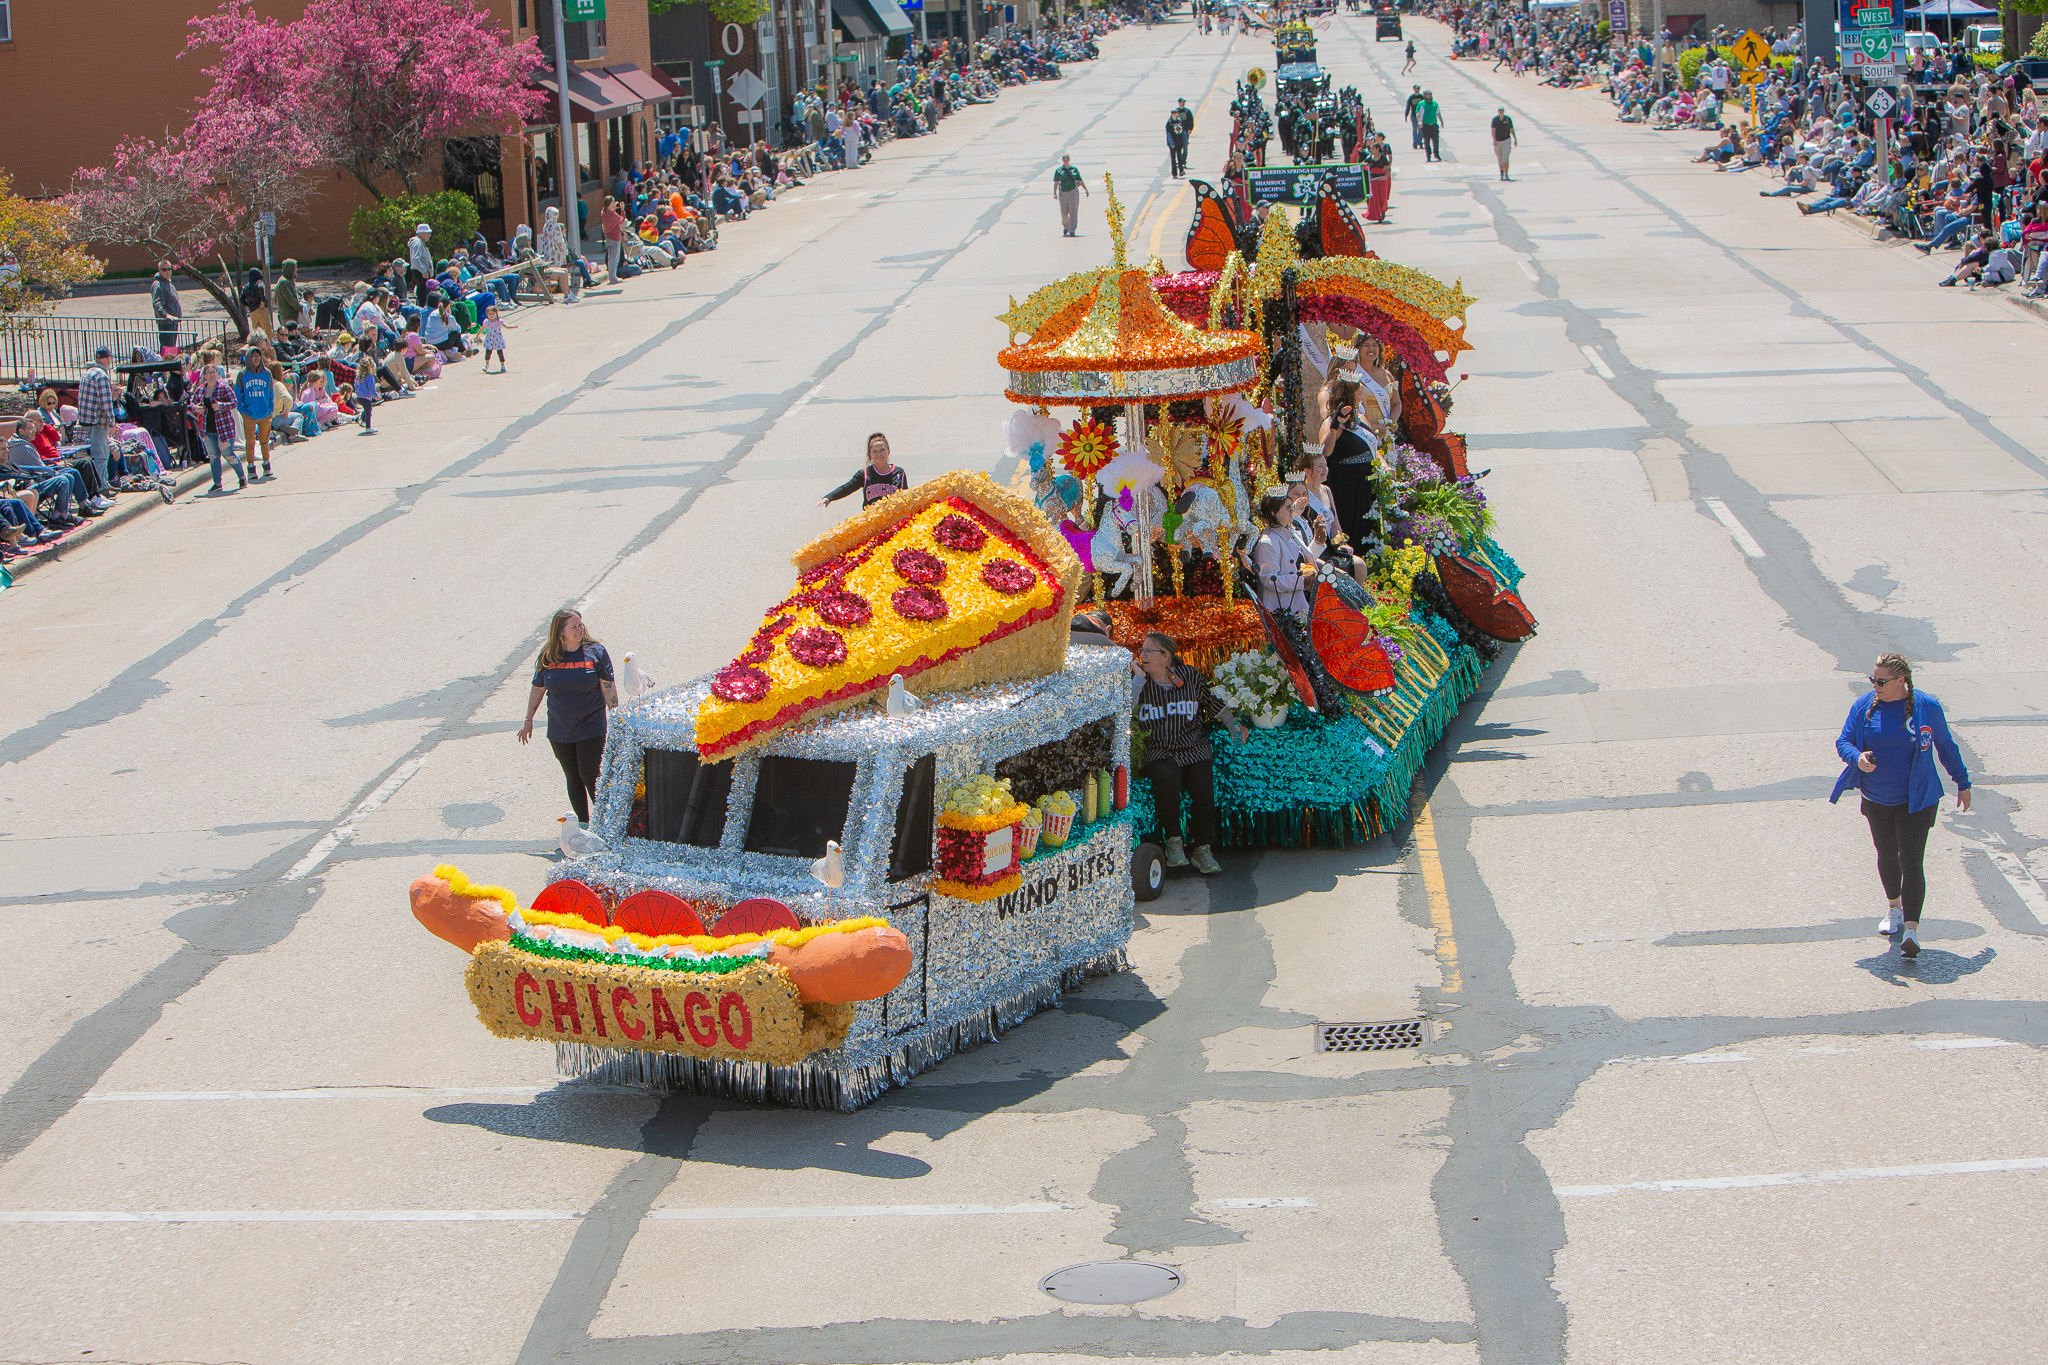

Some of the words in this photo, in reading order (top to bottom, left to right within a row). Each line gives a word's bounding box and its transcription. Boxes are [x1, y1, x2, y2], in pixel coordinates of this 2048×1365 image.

[1861, 11, 1888, 22] WEST
[1865, 37, 1888, 53] 94
[1864, 66, 1893, 77] SOUTH
[1872, 98, 1890, 111] 63
[245, 379, 267, 389] DETROIT
[248, 390, 265, 398] LIONS
[1067, 847, 1116, 892] BITES
[514, 971, 754, 1050] CHICAGO
